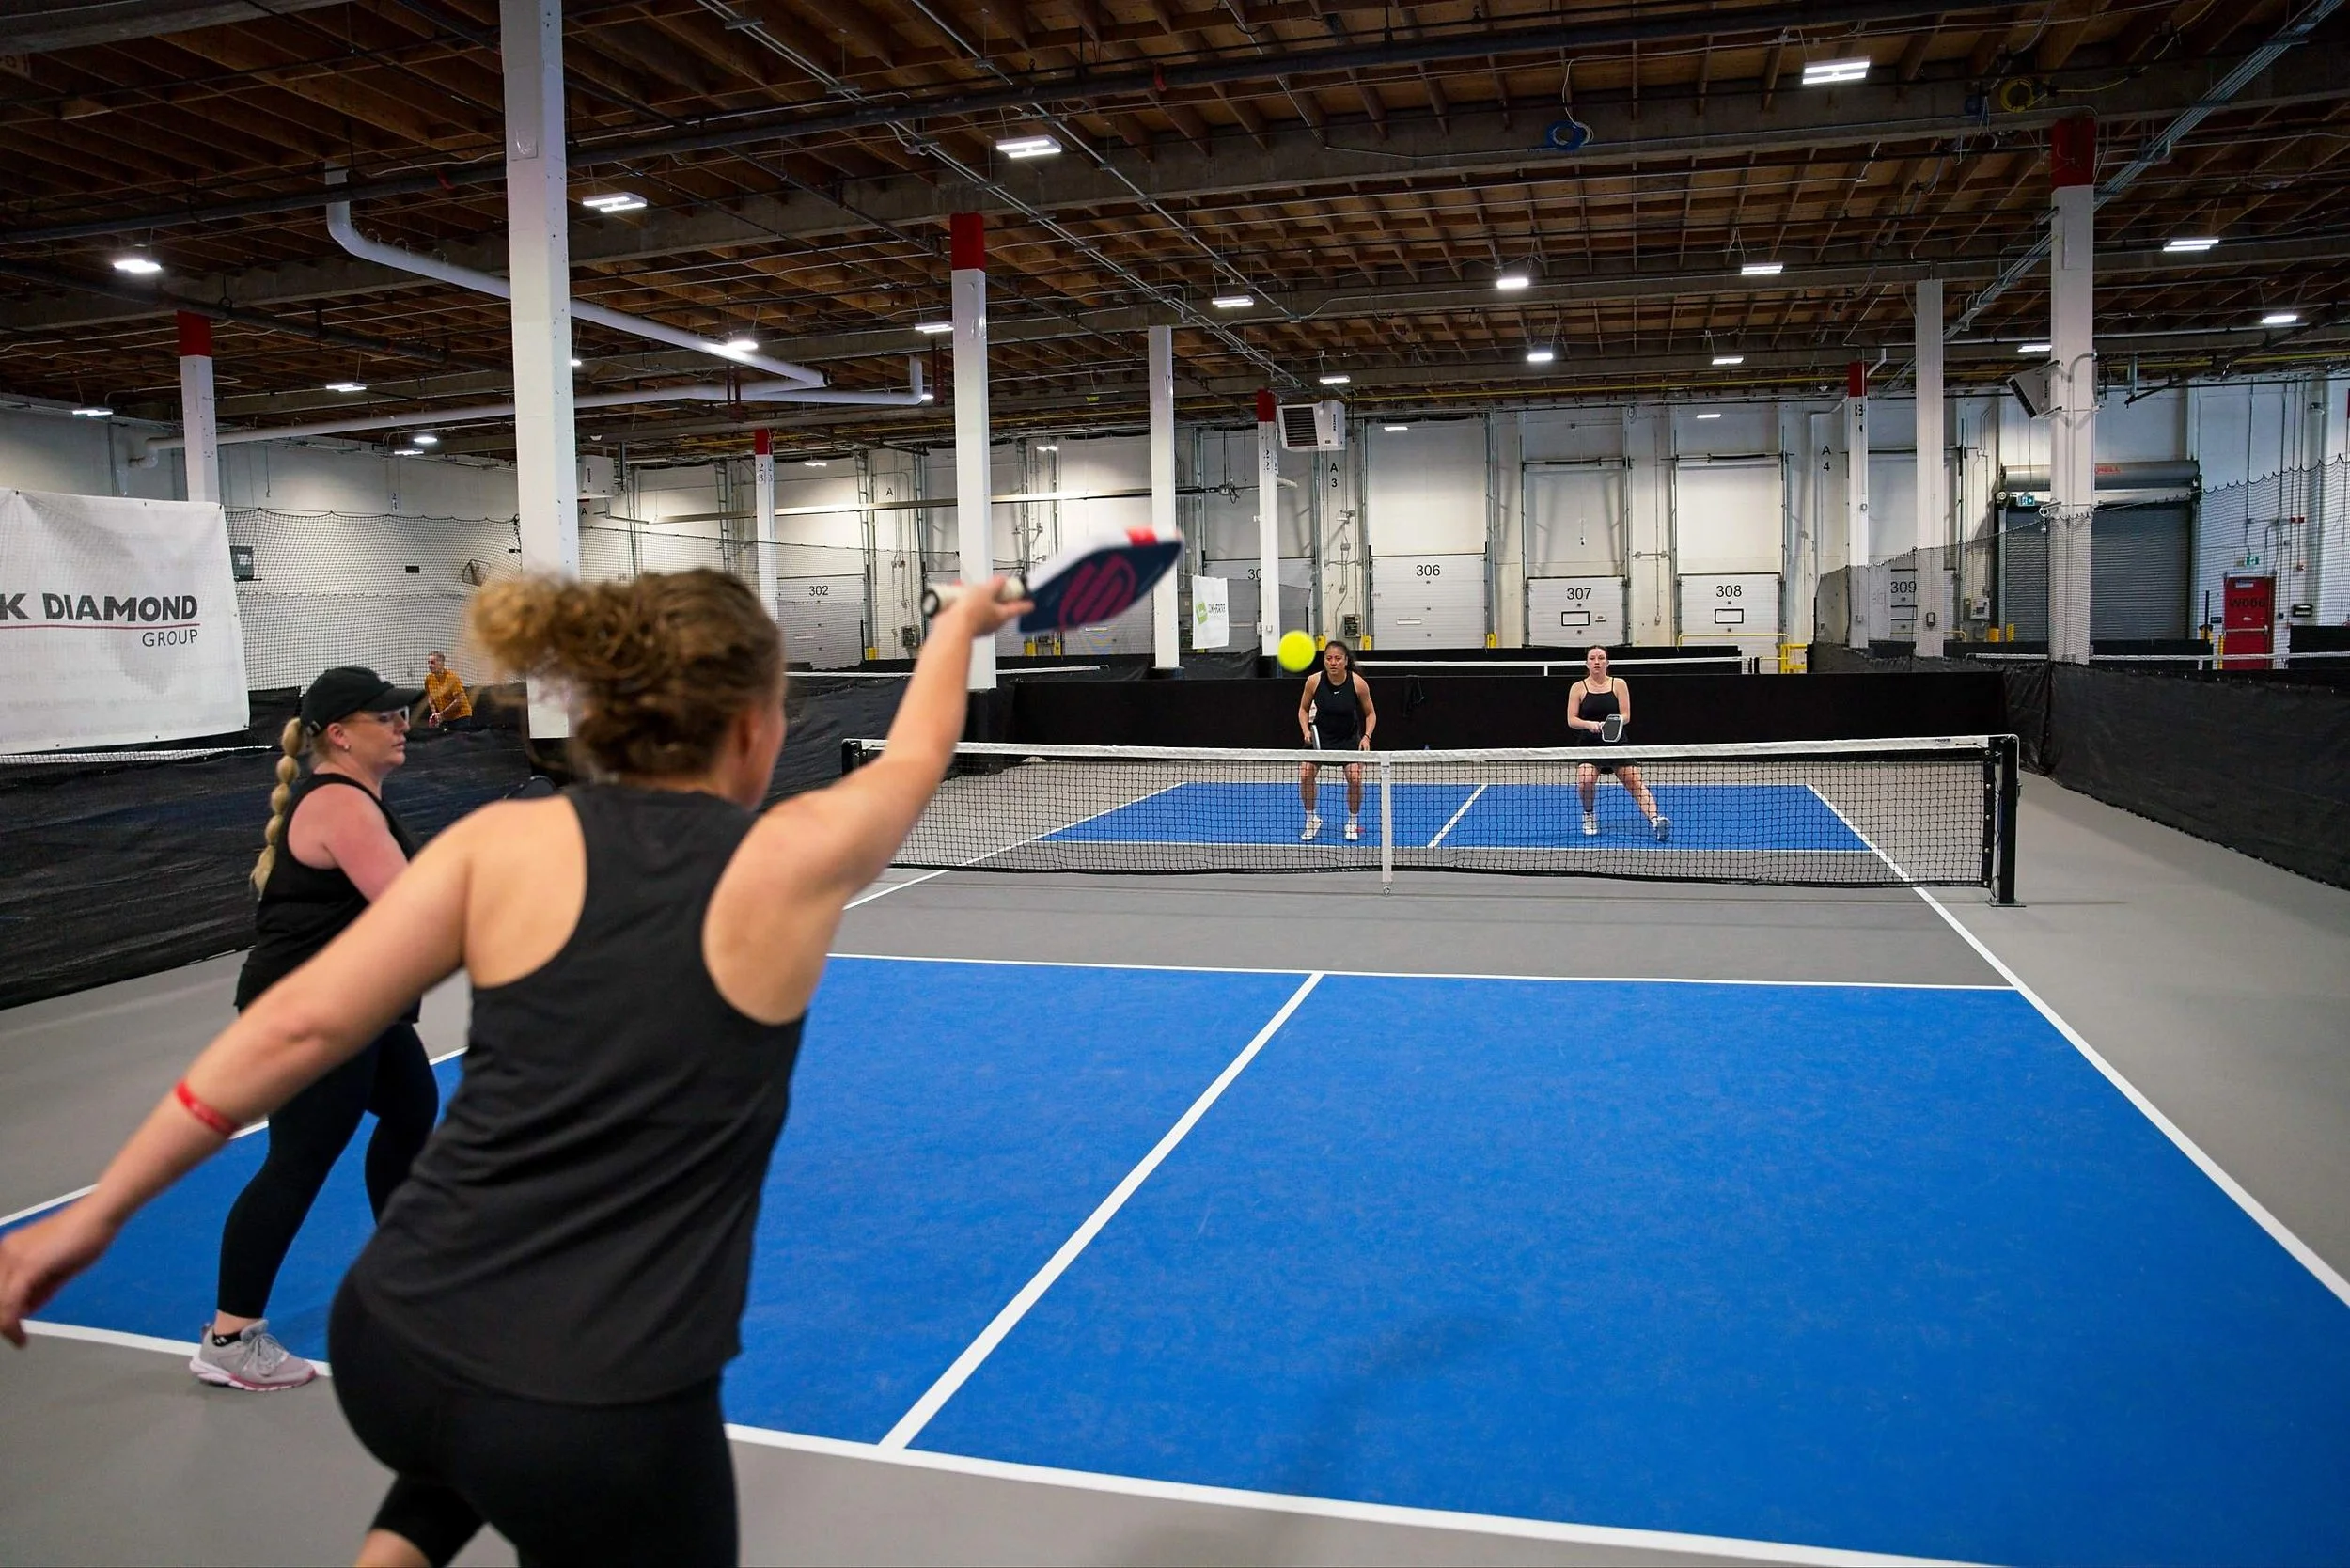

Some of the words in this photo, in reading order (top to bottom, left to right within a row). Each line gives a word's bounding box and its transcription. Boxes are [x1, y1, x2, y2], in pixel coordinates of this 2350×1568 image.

[1822, 446, 1831, 455] A
[1329, 463, 1339, 472] A
[1823, 462, 1830, 471] 4
[1331, 478, 1338, 487] 3
[886, 487, 893, 496] A
[1247, 568, 1261, 580] 30
[1416, 565, 1440, 576] 306
[808, 585, 829, 596] 302
[1716, 586, 1742, 598] 308
[1890, 582, 1916, 593] 309
[1567, 588, 1591, 600] 307
[0, 592, 30, 620] K
[42, 592, 198, 622] DIAMOND
[142, 629, 198, 647] GROUP
